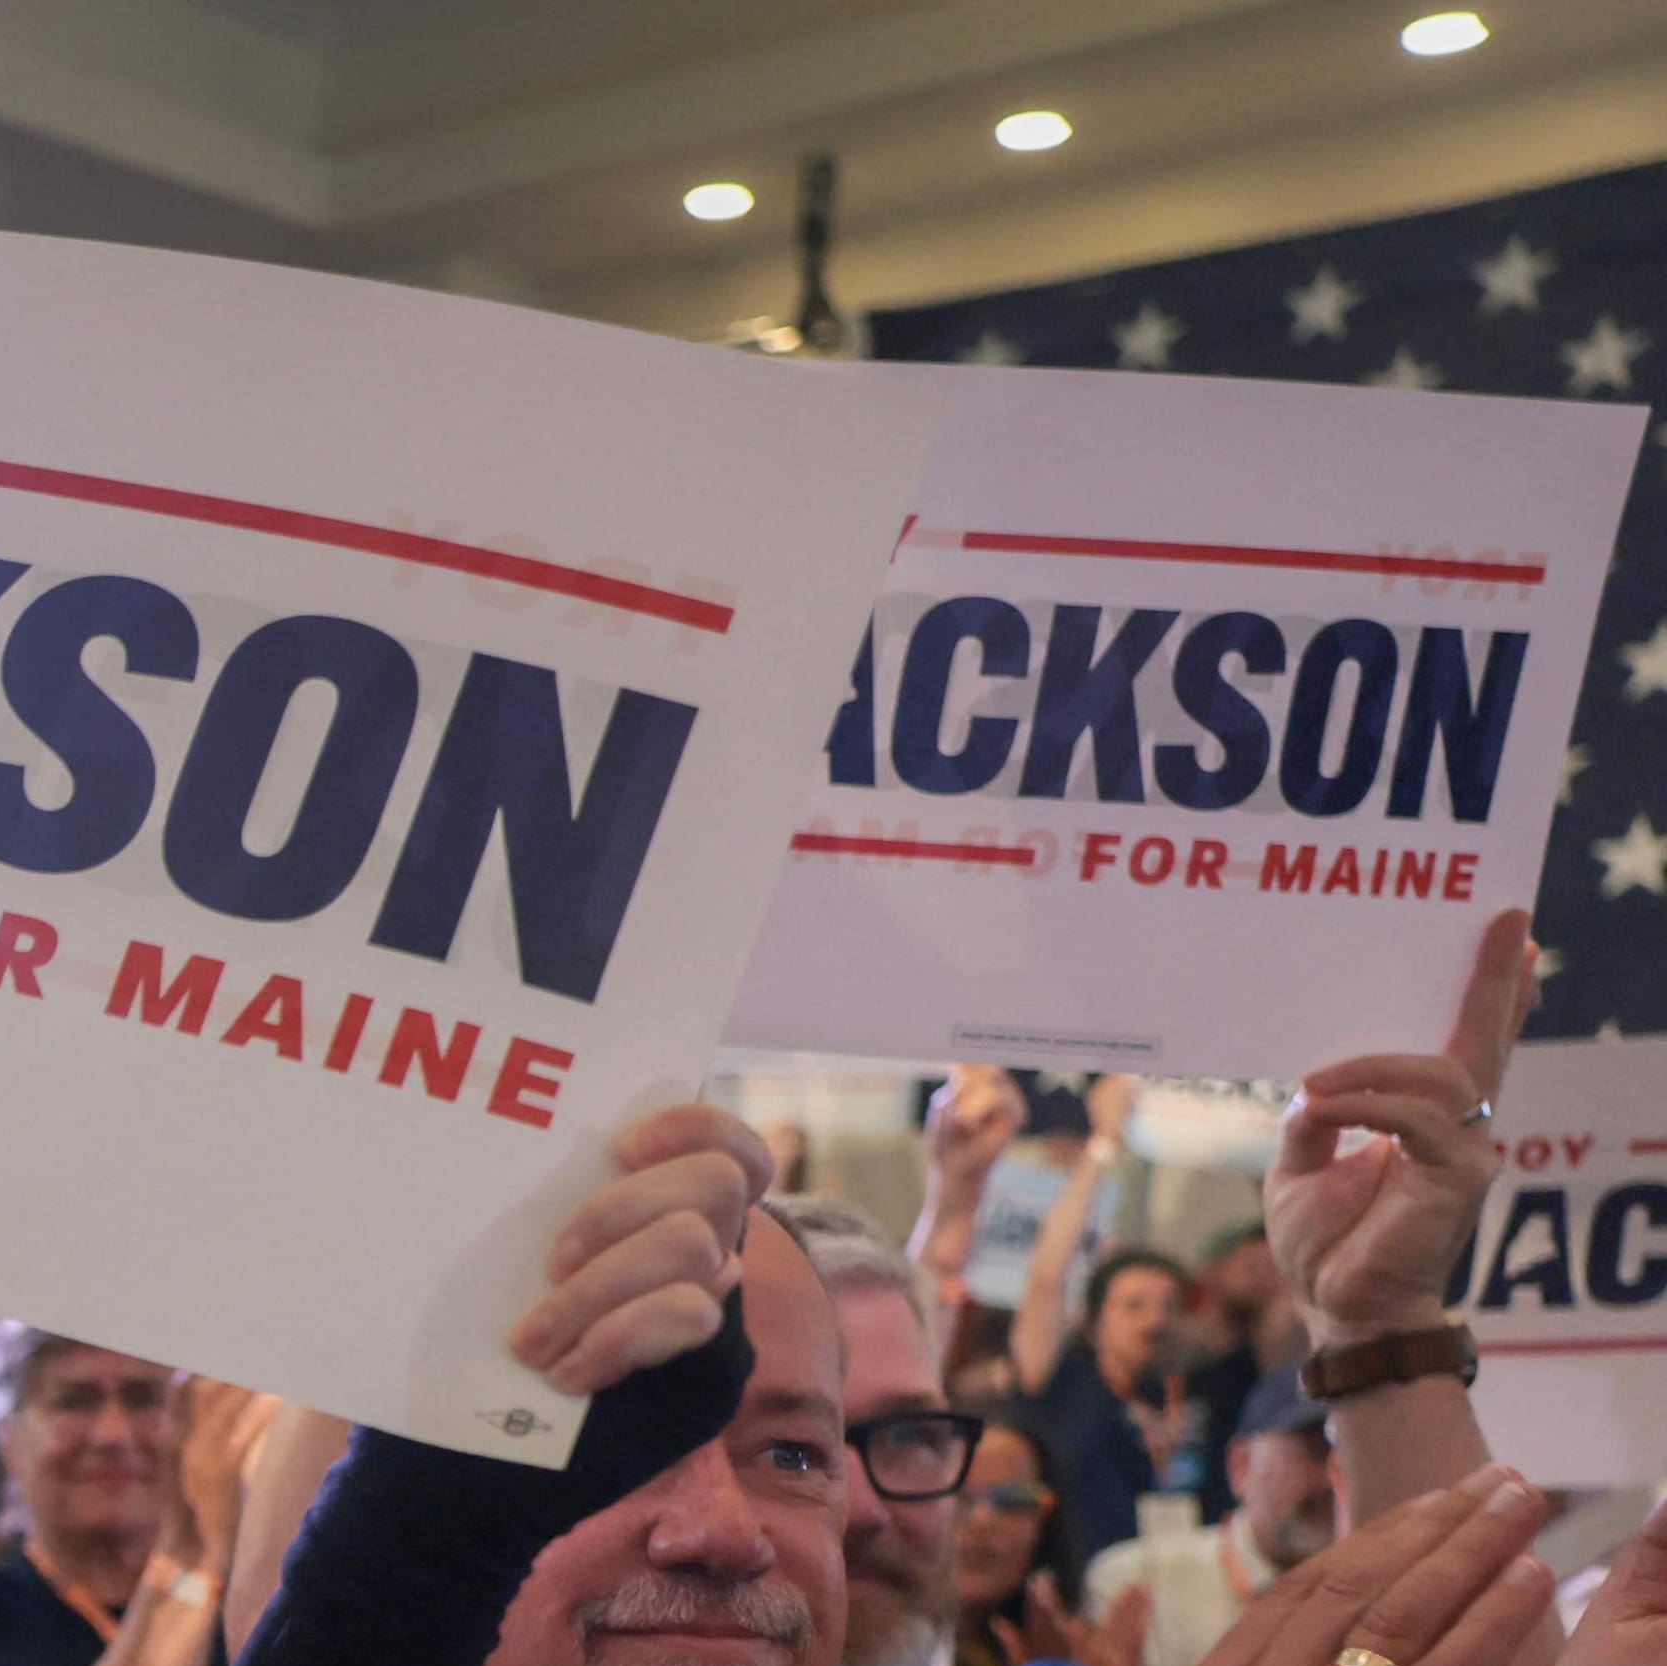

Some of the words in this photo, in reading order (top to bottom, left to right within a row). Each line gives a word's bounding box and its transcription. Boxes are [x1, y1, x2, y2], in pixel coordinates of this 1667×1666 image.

[1079, 832, 1230, 890] FOR
[1256, 842, 1481, 904] MAINE
[104, 940, 574, 1129] MAINE
[1492, 1132, 1595, 1171] OY
